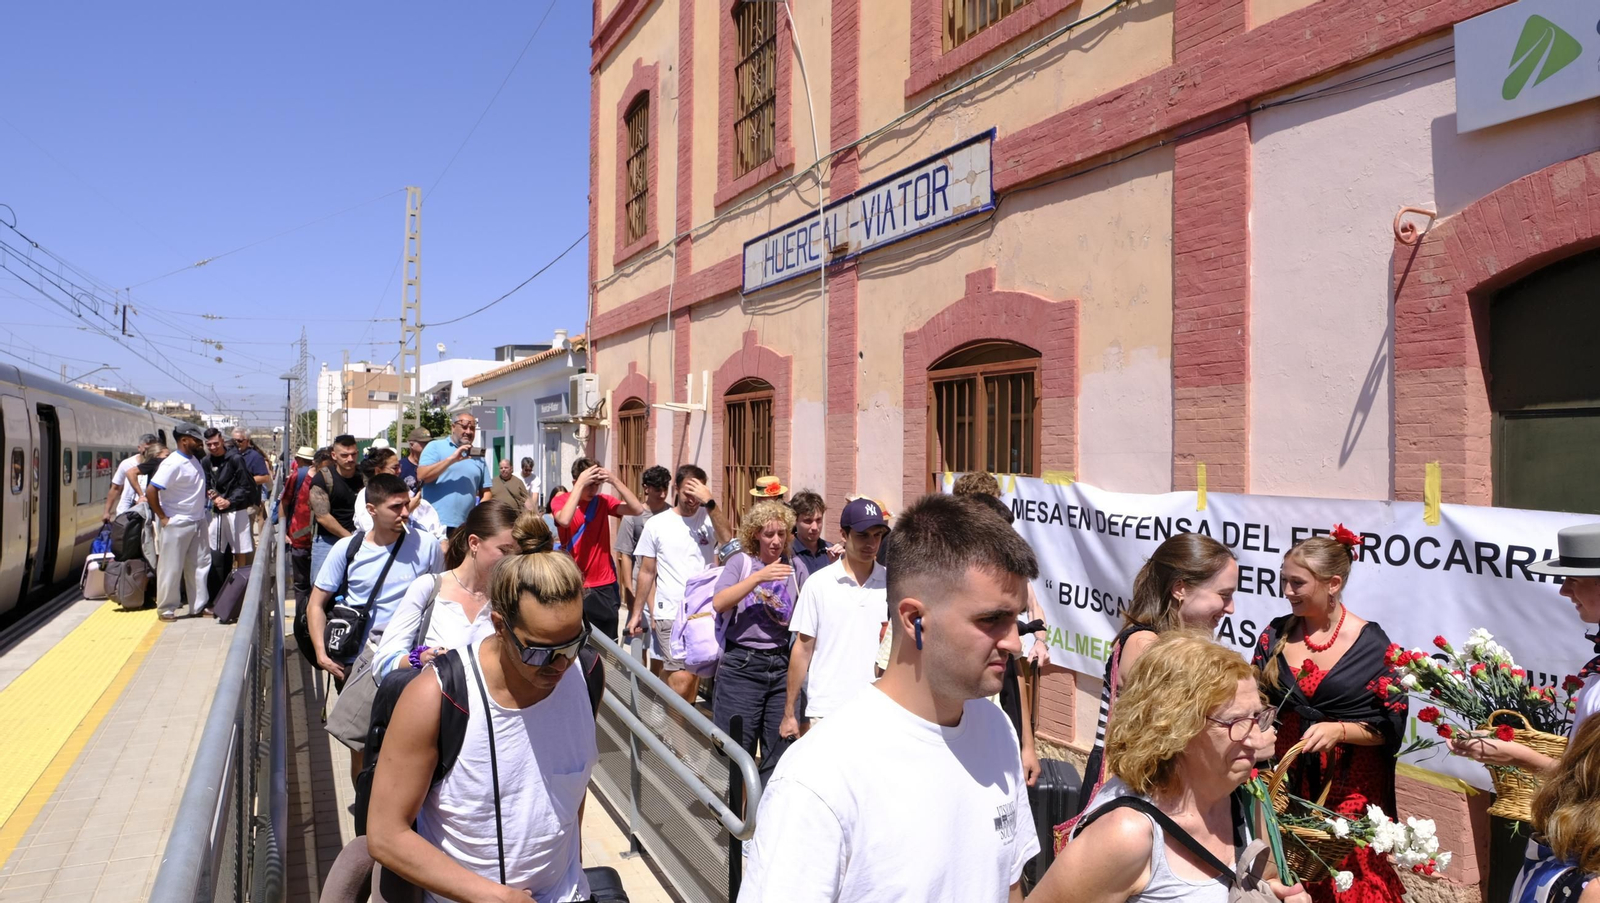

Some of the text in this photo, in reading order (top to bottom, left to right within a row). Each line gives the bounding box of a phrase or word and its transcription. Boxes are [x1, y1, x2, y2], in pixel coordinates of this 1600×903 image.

[1011, 498, 1064, 526] MESA
[1067, 505, 1092, 531] EN
[1095, 509, 1212, 541] DEFENSA
[1222, 521, 1281, 554] DEL
